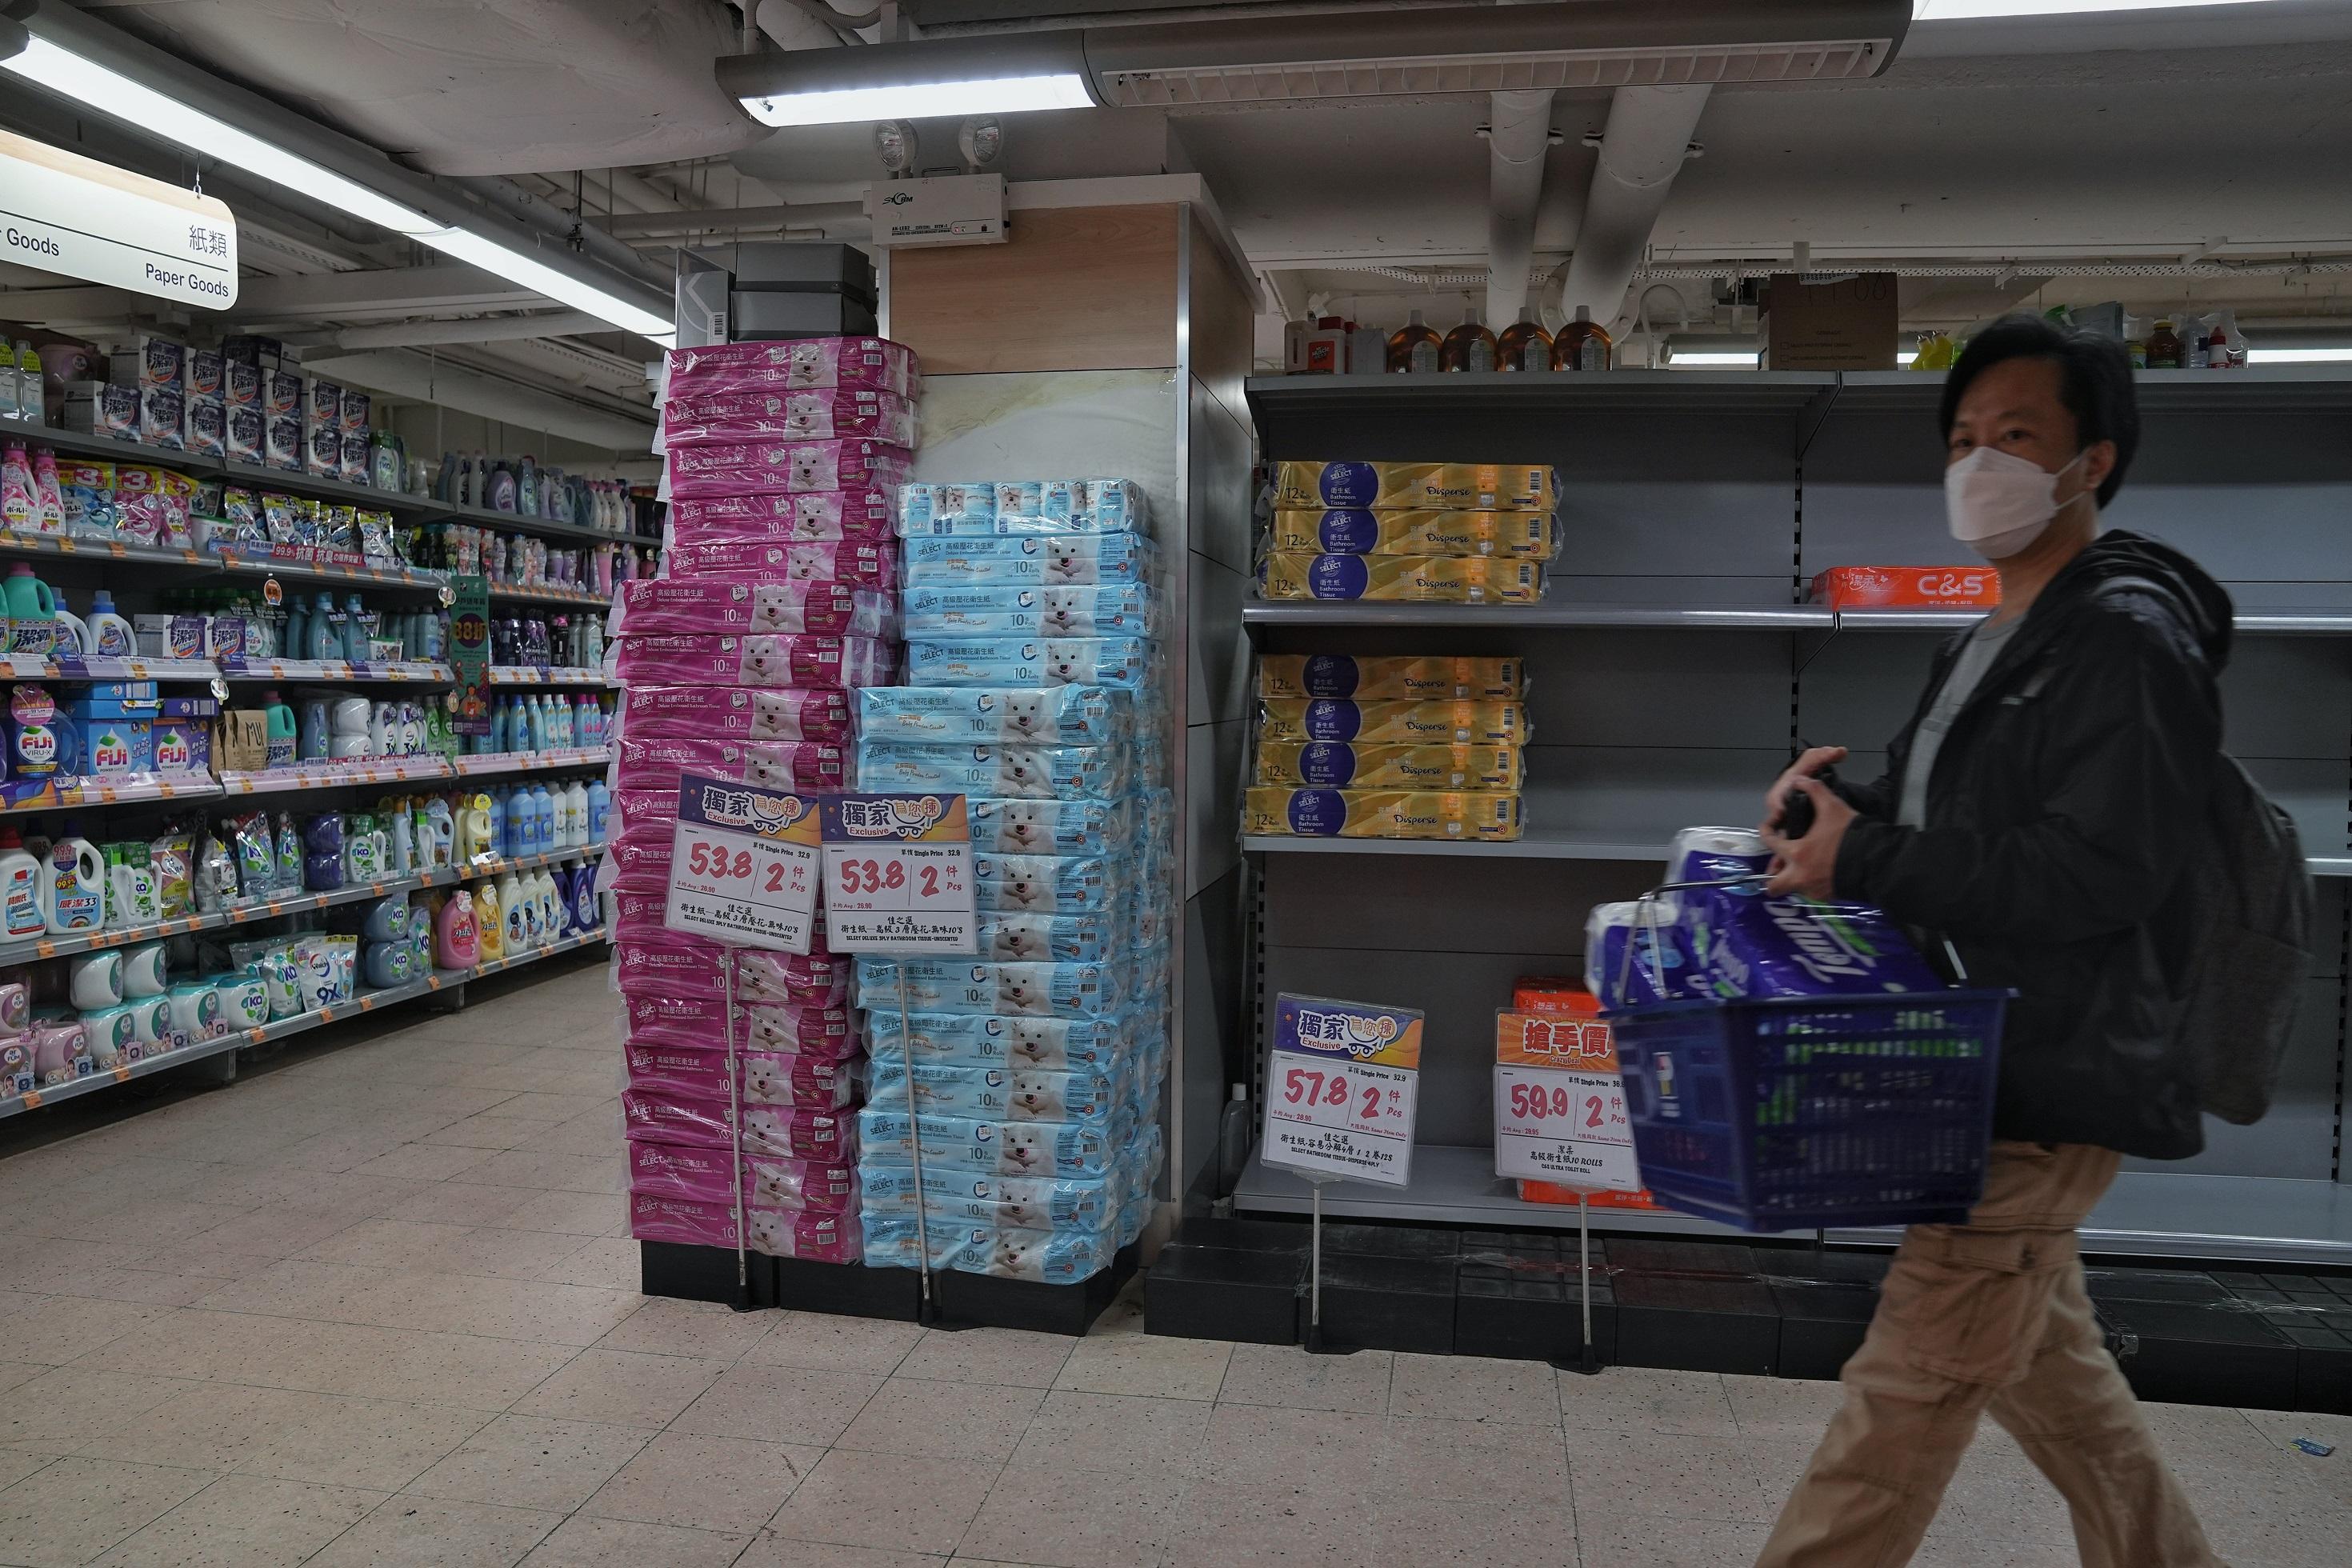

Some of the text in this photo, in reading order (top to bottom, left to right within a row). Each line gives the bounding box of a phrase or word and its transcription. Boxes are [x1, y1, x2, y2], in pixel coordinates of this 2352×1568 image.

[6, 226, 59, 257] Goods
[189, 224, 227, 258] 紙類
[145, 262, 229, 298] Paper Goods
[1286, 488, 1298, 499] 12
[1014, 561, 1028, 573] 10
[1918, 574, 1984, 596] C&S
[722, 609, 736, 622] 10
[704, 788, 750, 817] 獨家
[707, 811, 746, 826] Exclusive
[844, 802, 890, 826] 獨家
[1255, 814, 1268, 825] 12
[850, 827, 889, 836] Exclusive
[765, 845, 780, 854] Single
[781, 848, 794, 856] Price
[797, 850, 810, 859] 32.9
[689, 842, 785, 893] 53.8 2
[793, 866, 805, 879] 件
[946, 865, 958, 878] 件
[841, 859, 939, 898] 53.8 2
[790, 882, 806, 893] Pcs
[946, 882, 962, 890] Pcs
[727, 903, 752, 916] 佳之選
[699, 917, 714, 925] DELUXE
[726, 922, 753, 933] BATHROOM
[887, 916, 914, 926] 佳之選
[1300, 1012, 1345, 1040] 獨家
[1302, 1037, 1341, 1050] Exclusive
[1525, 1022, 1609, 1056] 搶手價
[1550, 1056, 1566, 1064] Crazy
[1360, 1069, 1375, 1078] Single
[1375, 1072, 1389, 1080] Price
[1393, 1074, 1406, 1082] 32.9
[1284, 1069, 1381, 1119] 57.8 2
[1388, 1090, 1401, 1103] 件
[1510, 1083, 1604, 1128] 59.9 2
[1610, 1096, 1622, 1110] 件
[1386, 1106, 1402, 1118] Pcs
[1610, 1114, 1626, 1124] Pcs
[1324, 1132, 1349, 1145] 佳之選
[1291, 1146, 1306, 1154] SELECT
[1306, 1149, 1331, 1159] BATHROOM
[1558, 1145, 1574, 1154] 潔柔
[1581, 1158, 1603, 1166] ROLLS
